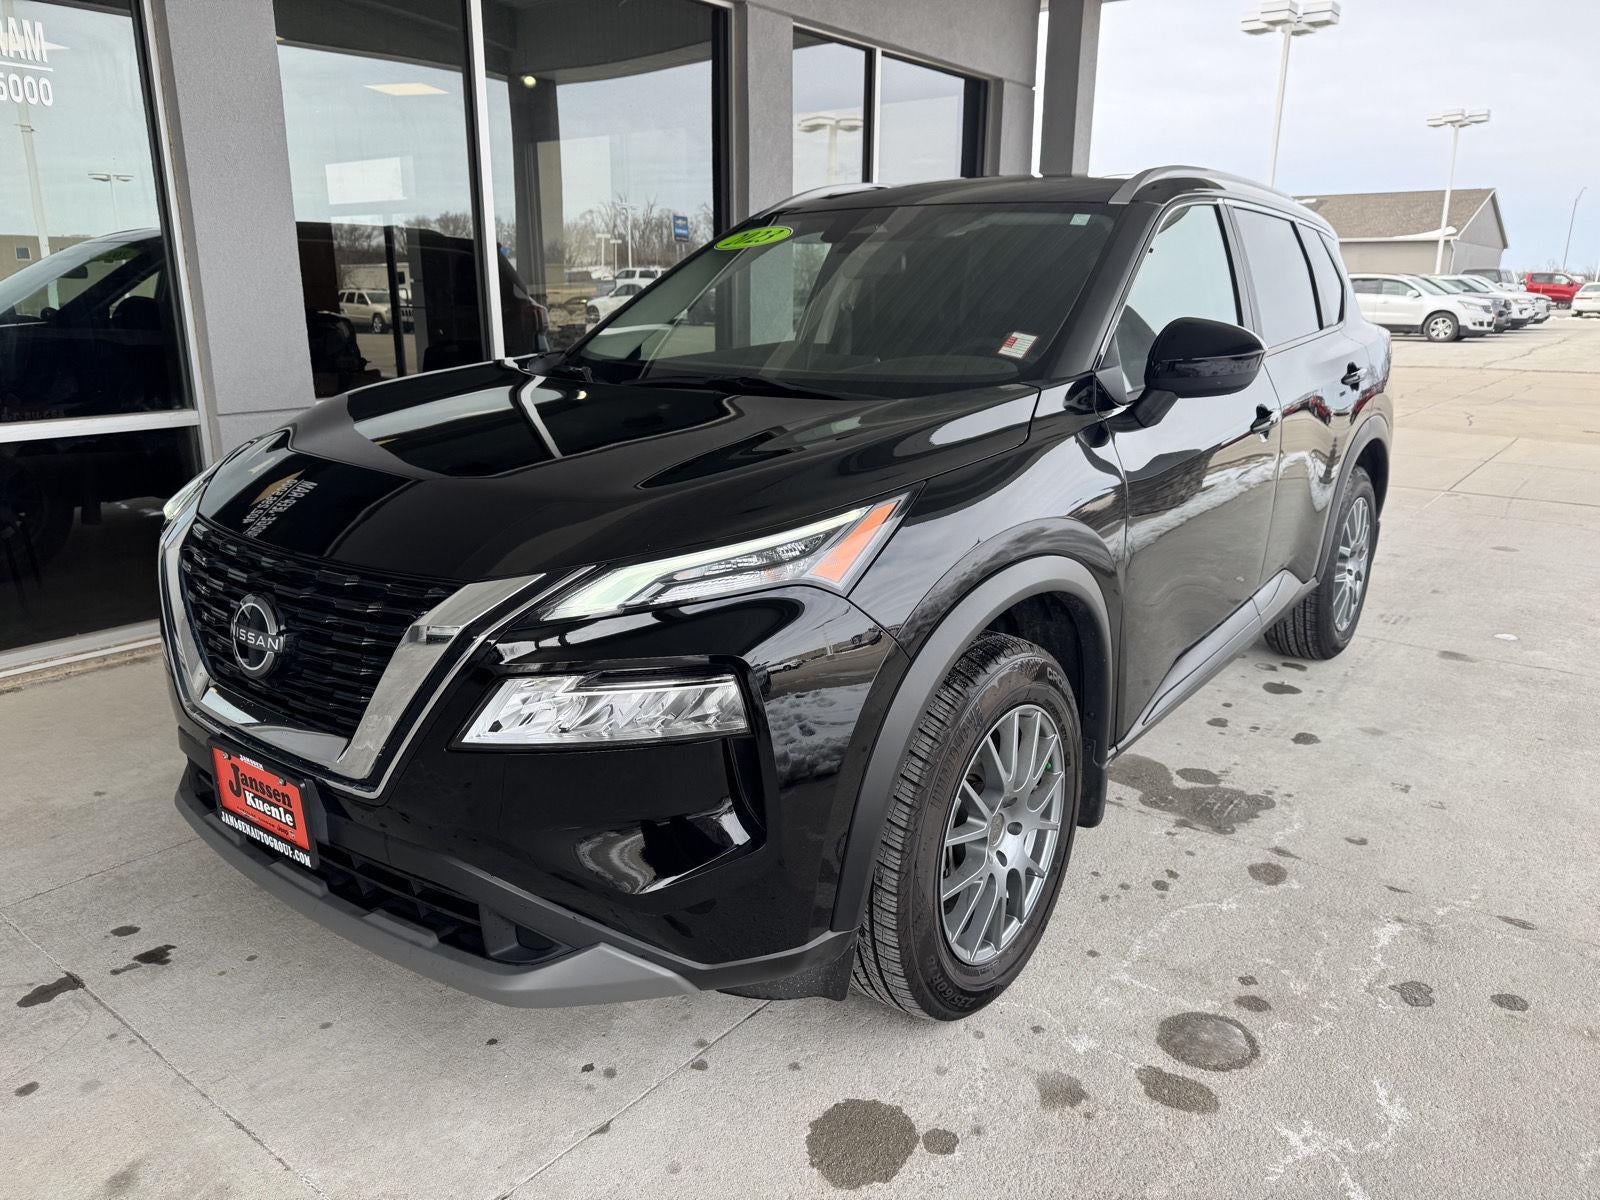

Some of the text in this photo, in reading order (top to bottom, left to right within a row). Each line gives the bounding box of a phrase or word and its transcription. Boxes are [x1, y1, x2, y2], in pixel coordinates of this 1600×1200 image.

[235, 626, 279, 650] ISSAN
[228, 763, 292, 808] Janssen
[244, 791, 294, 826] Kuenle
